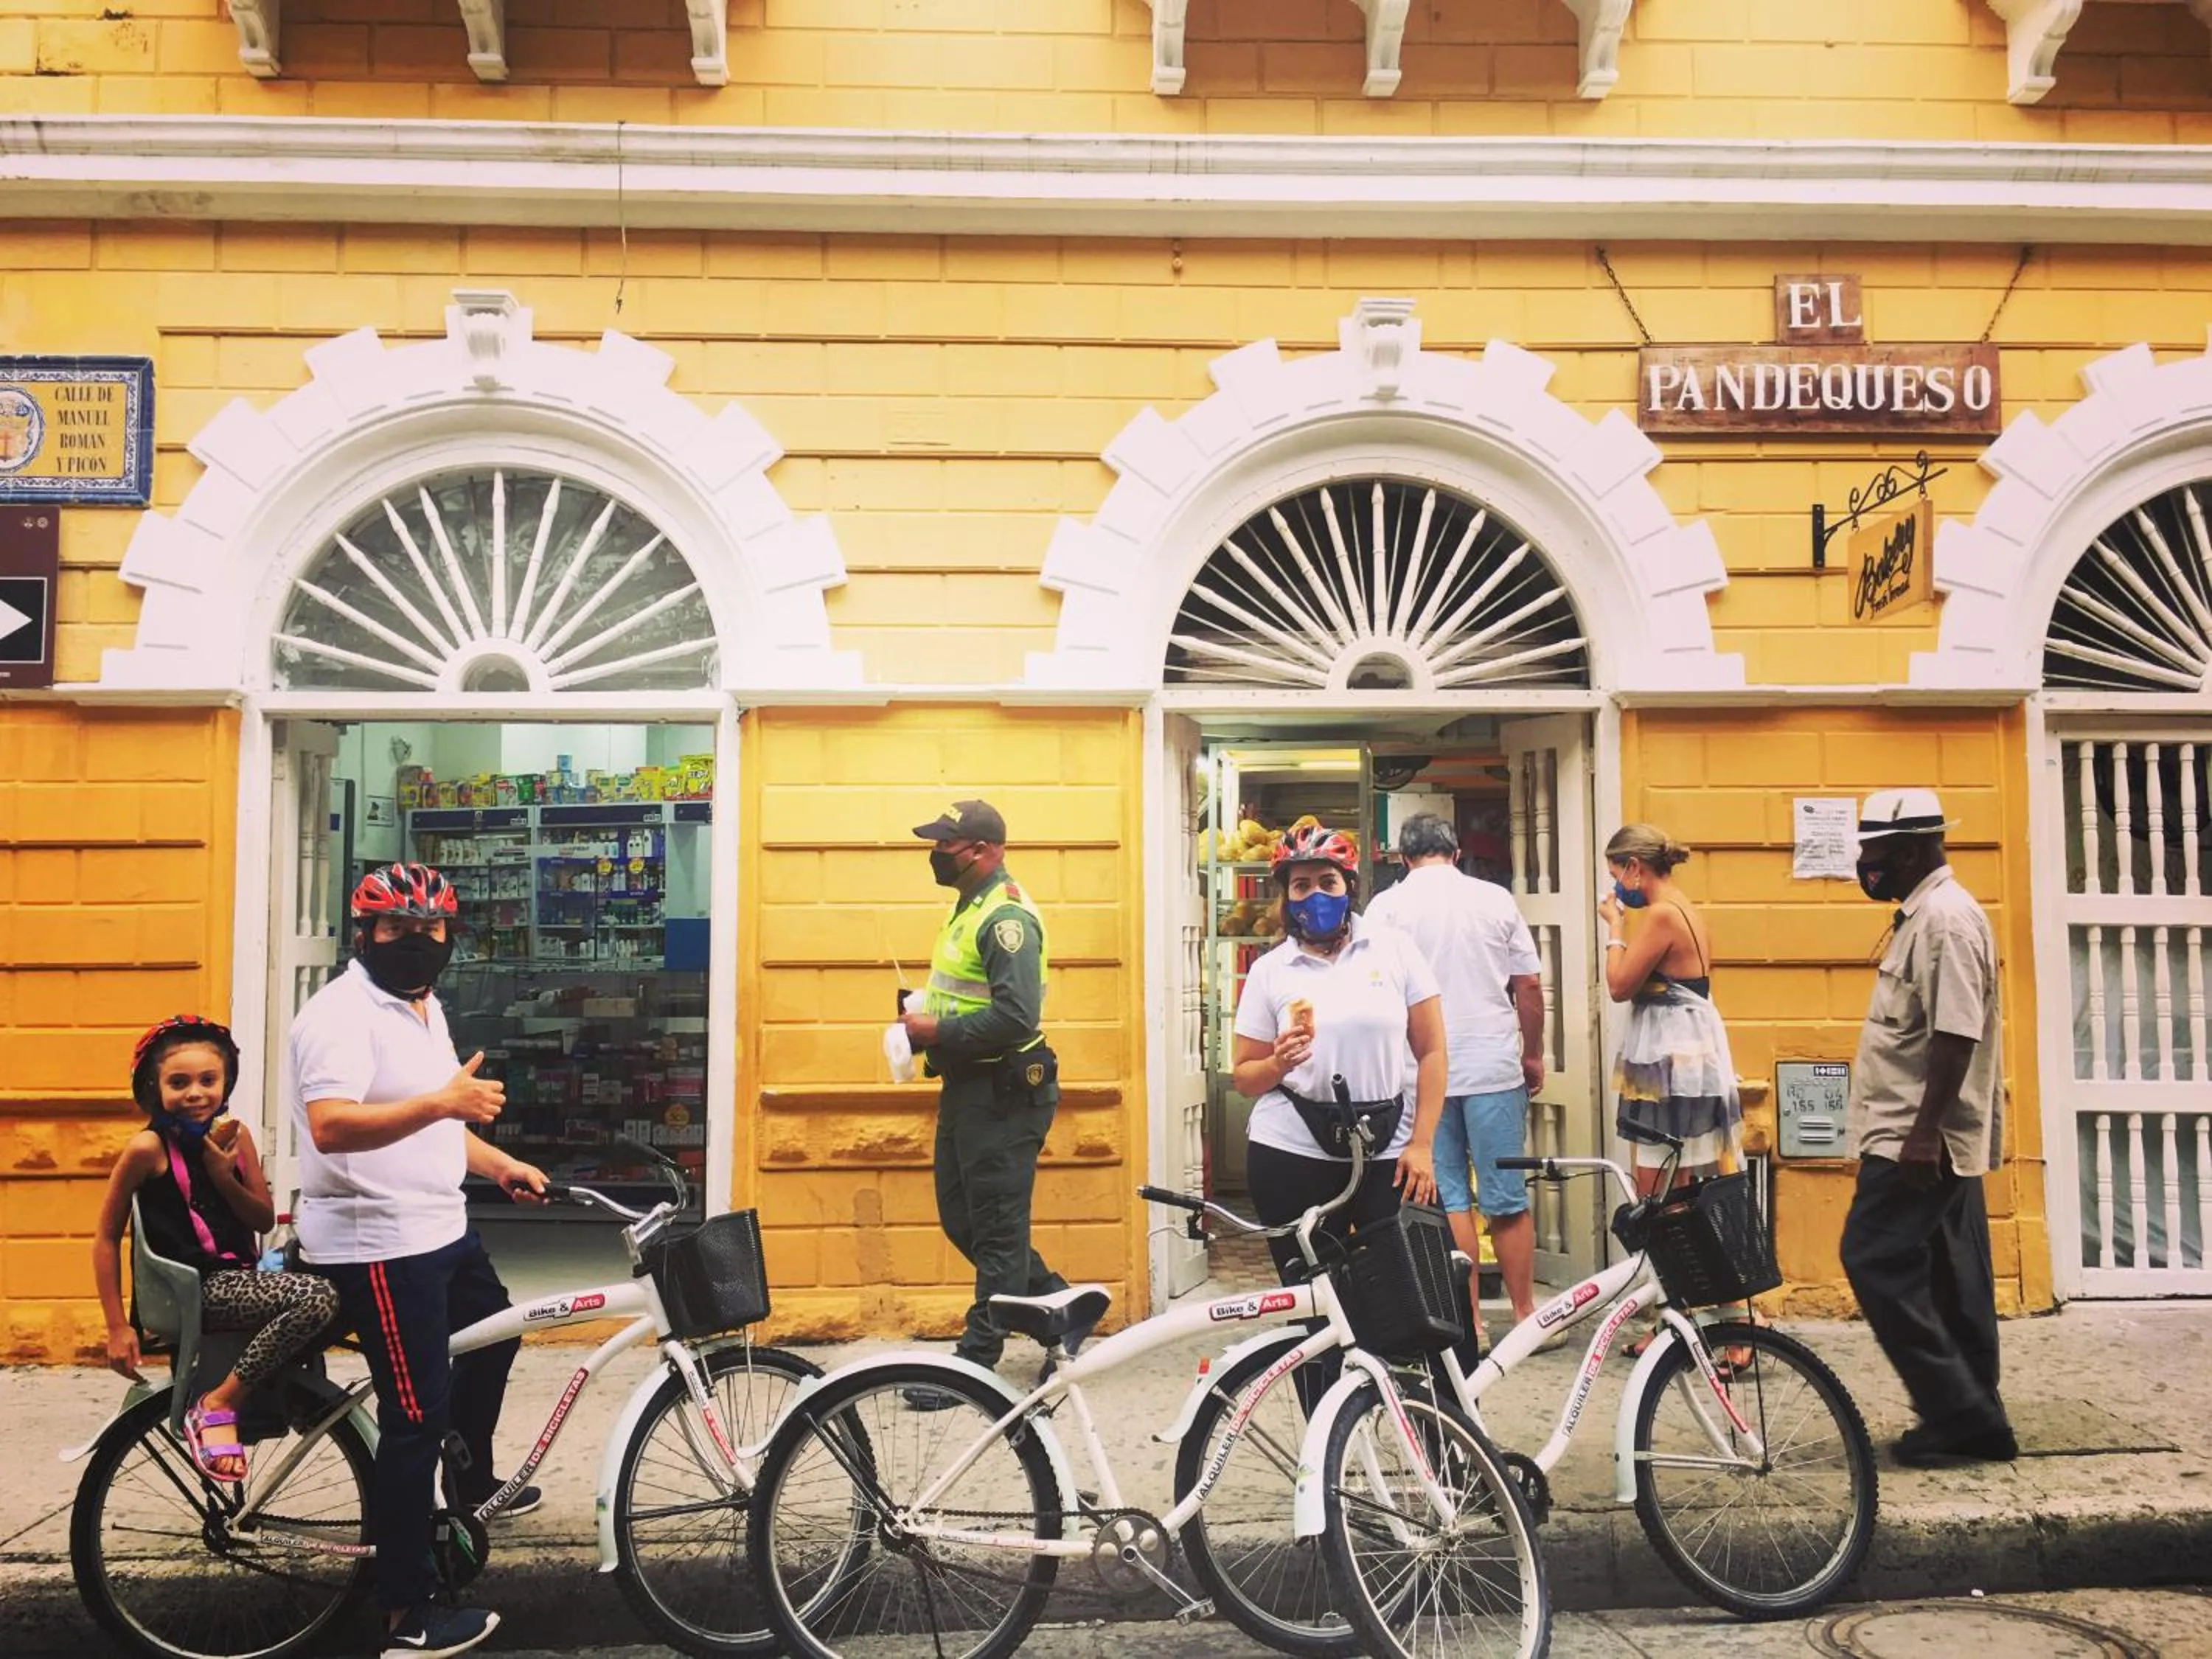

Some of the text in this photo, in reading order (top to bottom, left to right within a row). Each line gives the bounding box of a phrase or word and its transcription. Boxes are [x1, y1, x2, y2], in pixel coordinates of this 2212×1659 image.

[1787, 282, 1863, 328] EL
[55, 386, 114, 403] CALLE DE
[1646, 364, 1992, 413] PANDEQUESO
[58, 409, 110, 425] MANUEL
[60, 433, 105, 449] ROMAN
[56, 456, 66, 473] Y
[529, 1298, 600, 1318] Bike & Arts
[1216, 1298, 1289, 1316] Bike & Arts
[483, 1370, 585, 1520] ALQUILER DE BICICLETAS
[1198, 1432, 1237, 1500] ALQUILER
